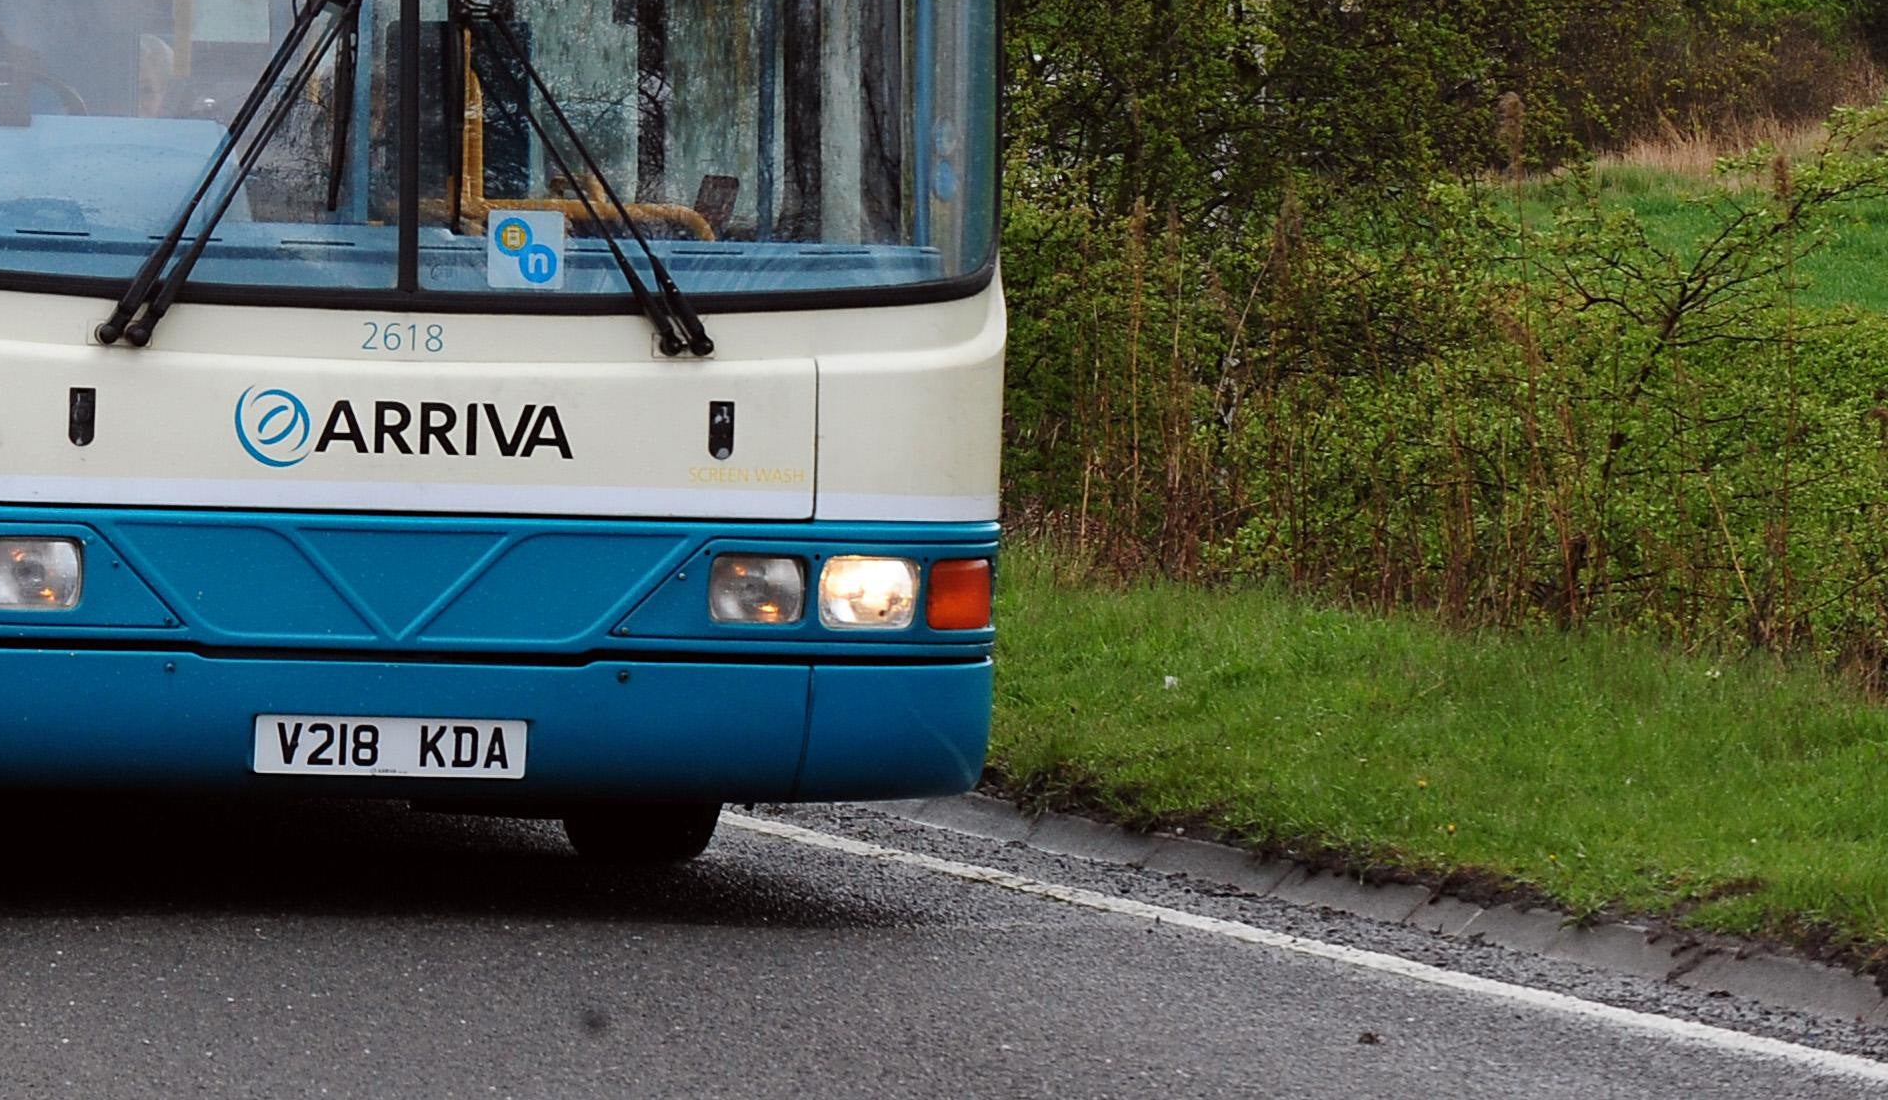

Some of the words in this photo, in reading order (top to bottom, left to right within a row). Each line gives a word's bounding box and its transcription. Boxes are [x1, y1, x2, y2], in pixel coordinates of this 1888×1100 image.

[362, 322, 443, 352] 2618
[314, 400, 574, 459] ARRIVA
[688, 468, 749, 483] SCREEN
[755, 468, 806, 483] WASH
[277, 722, 379, 767] V218
[419, 725, 509, 769] KDA
